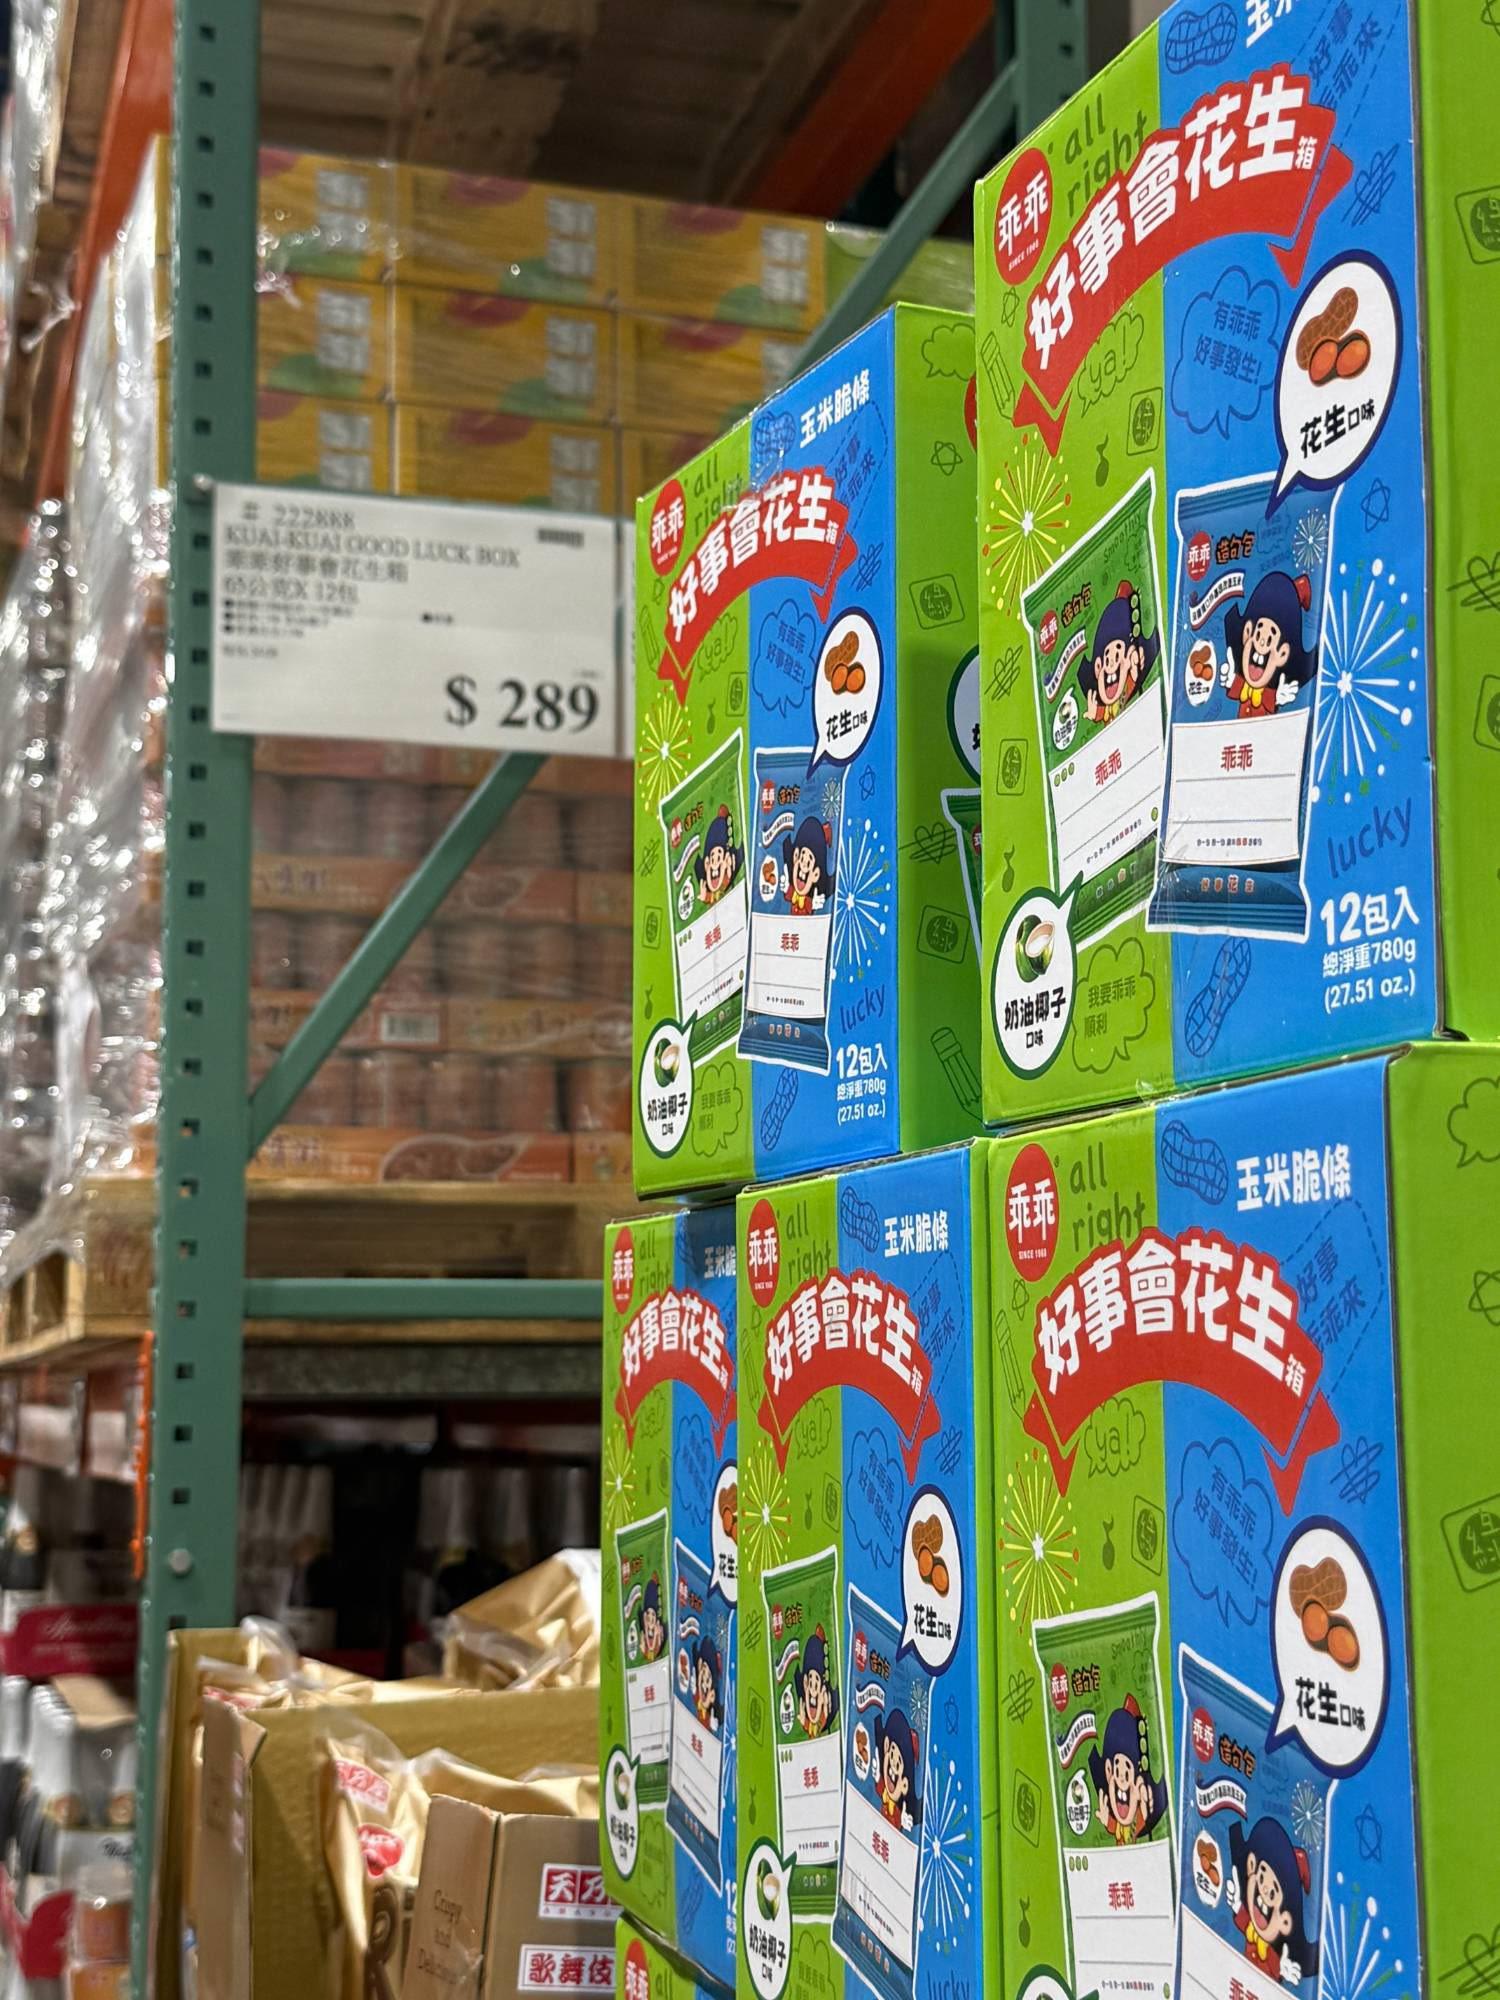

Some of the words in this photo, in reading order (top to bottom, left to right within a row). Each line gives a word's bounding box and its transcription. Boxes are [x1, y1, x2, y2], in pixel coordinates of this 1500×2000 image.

[1065, 93, 1105, 165] all
[1067, 109, 1147, 218] right
[998, 169, 1048, 257] 乖乖
[1028, 75, 1318, 370] 好事會花生箱
[1214, 299, 1262, 342] 有乖乖
[1089, 325, 1127, 392] ya!
[1193, 333, 1263, 385] 好事發生!
[800, 368, 870, 448] 玉米脆條
[1300, 398, 1376, 459] 花生口味
[694, 453, 718, 498] all
[225, 525, 341, 553] KUAI-KUAI
[344, 535, 410, 559] GOOD
[414, 541, 470, 564] LUCK
[477, 546, 520, 569] BOX
[652, 497, 684, 554] 乖乖
[669, 473, 838, 642] 好事會花生箱
[1188, 542, 1211, 568] 乖乖
[446, 674, 478, 729] $
[500, 677, 600, 733] 289
[826, 709, 868, 743] 花生口味
[1095, 748, 1122, 787] 乖乖
[1221, 743, 1253, 772] 乖乖
[1327, 797, 1412, 880] lucky
[1320, 886, 1420, 946] 12包入
[780, 933, 800, 953] 乖乖
[1322, 936, 1416, 978] 總淨重780g
[840, 984, 886, 1035] lucky
[1004, 986, 1066, 1031] 奶油椰子
[1088, 975, 1136, 1009] 我要乖乖
[1324, 977, 1374, 1015] (27.51
[1380, 968, 1416, 1009] oz.)
[836, 1043, 888, 1080] 12包入
[1026, 1029, 1044, 1049] 口味
[647, 1092, 688, 1122] 奶油椰子
[837, 1105, 864, 1126] (27.51
[1070, 1142, 1107, 1194] all
[1236, 1143, 1352, 1212] 玉米脆條
[786, 1200, 808, 1240] all
[884, 1209, 948, 1257] 玉米脆條
[1008, 1178, 1055, 1244] 乖乖
[1073, 1191, 1146, 1252] right
[613, 1248, 633, 1290] 乖乖
[749, 1226, 778, 1277] 乖乖
[1297, 1235, 1339, 1314] 好事
[768, 1276, 923, 1397] 好事會花生箱
[1038, 1238, 1307, 1397] 好事會花生箱
[1094, 1416, 1131, 1457] ya!
[1212, 1464, 1257, 1541] 有乖乖
[914, 1602, 951, 1640] 花生口味
[1051, 1674, 1068, 1698] 乖乖
[1295, 1675, 1367, 1732] 花生口味
[1192, 1718, 1214, 1751] 乖乖
[1108, 1881, 1135, 1910] 乖乖
[529, 1952, 614, 1985] 歌舞伎
[749, 1923, 786, 1968] 奶油椰子
